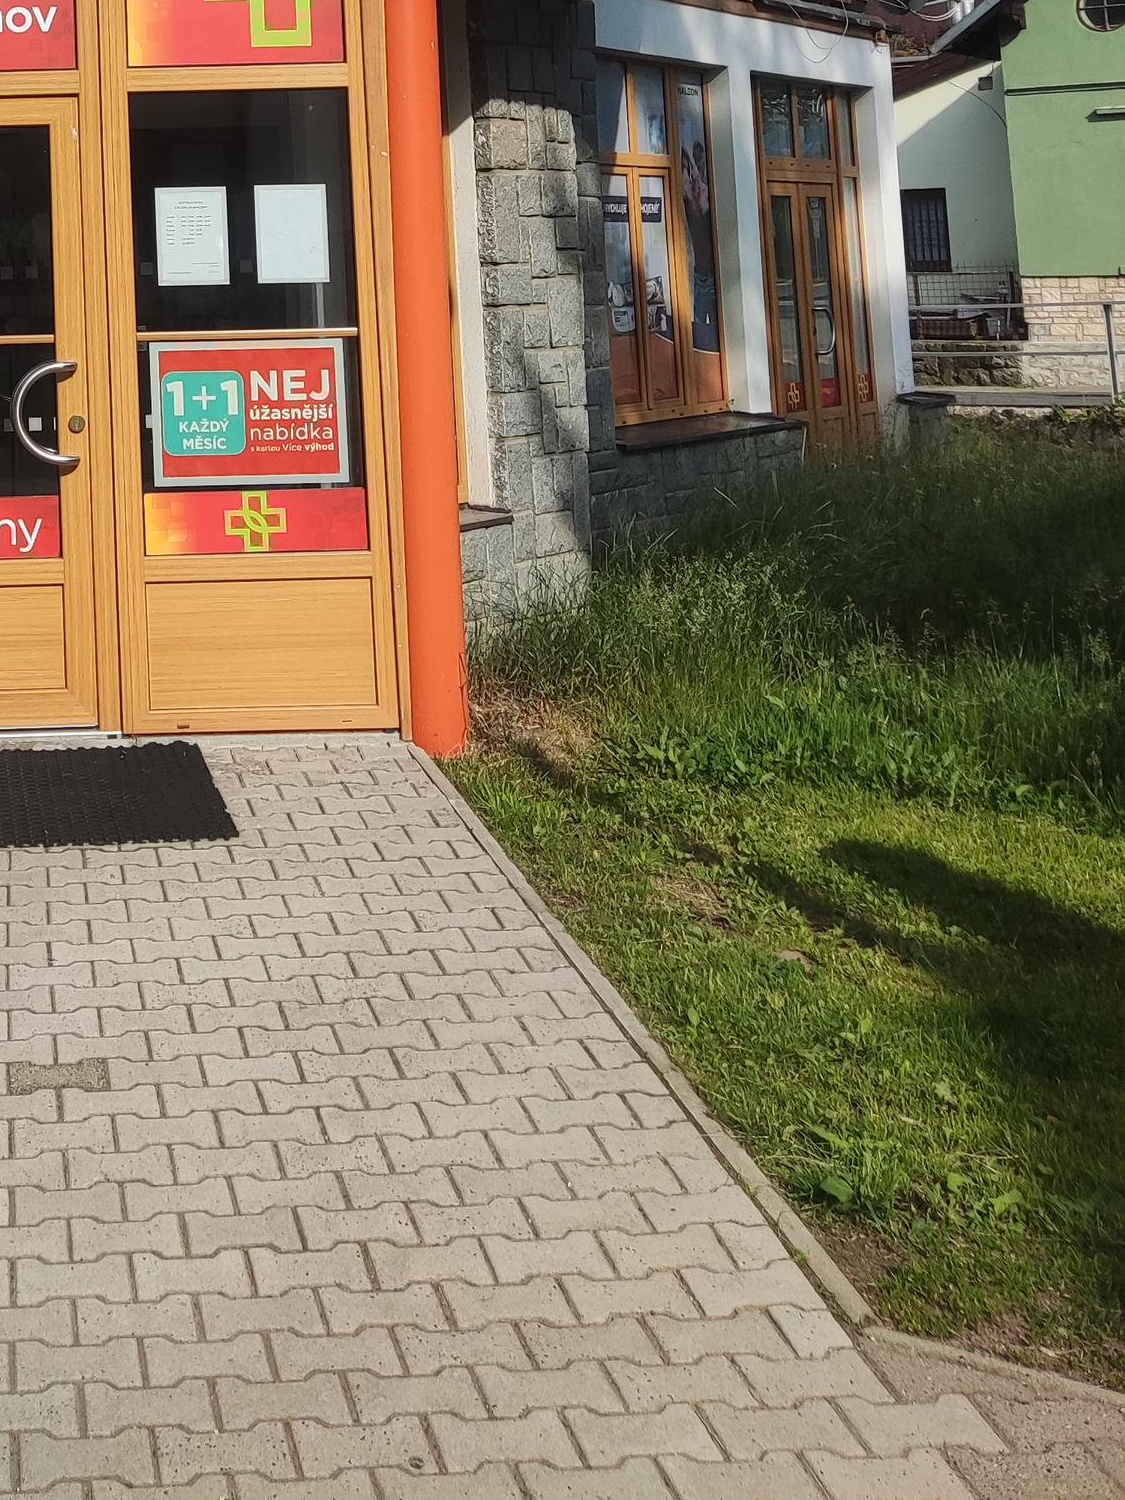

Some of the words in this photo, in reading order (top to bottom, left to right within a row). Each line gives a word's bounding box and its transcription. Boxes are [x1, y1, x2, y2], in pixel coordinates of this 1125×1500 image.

[249, 369, 331, 402] NEJ
[166, 379, 240, 417] 1+1
[249, 404, 334, 423] úžasnější
[179, 418, 230, 434] KAŽDÝ
[249, 423, 334, 442] nabídka
[182, 435, 228, 450] MĚSÍC
[250, 445, 255, 453] s
[256, 445, 280, 453] kartou
[281, 442, 303, 452] Více
[304, 442, 335, 454] výhod
